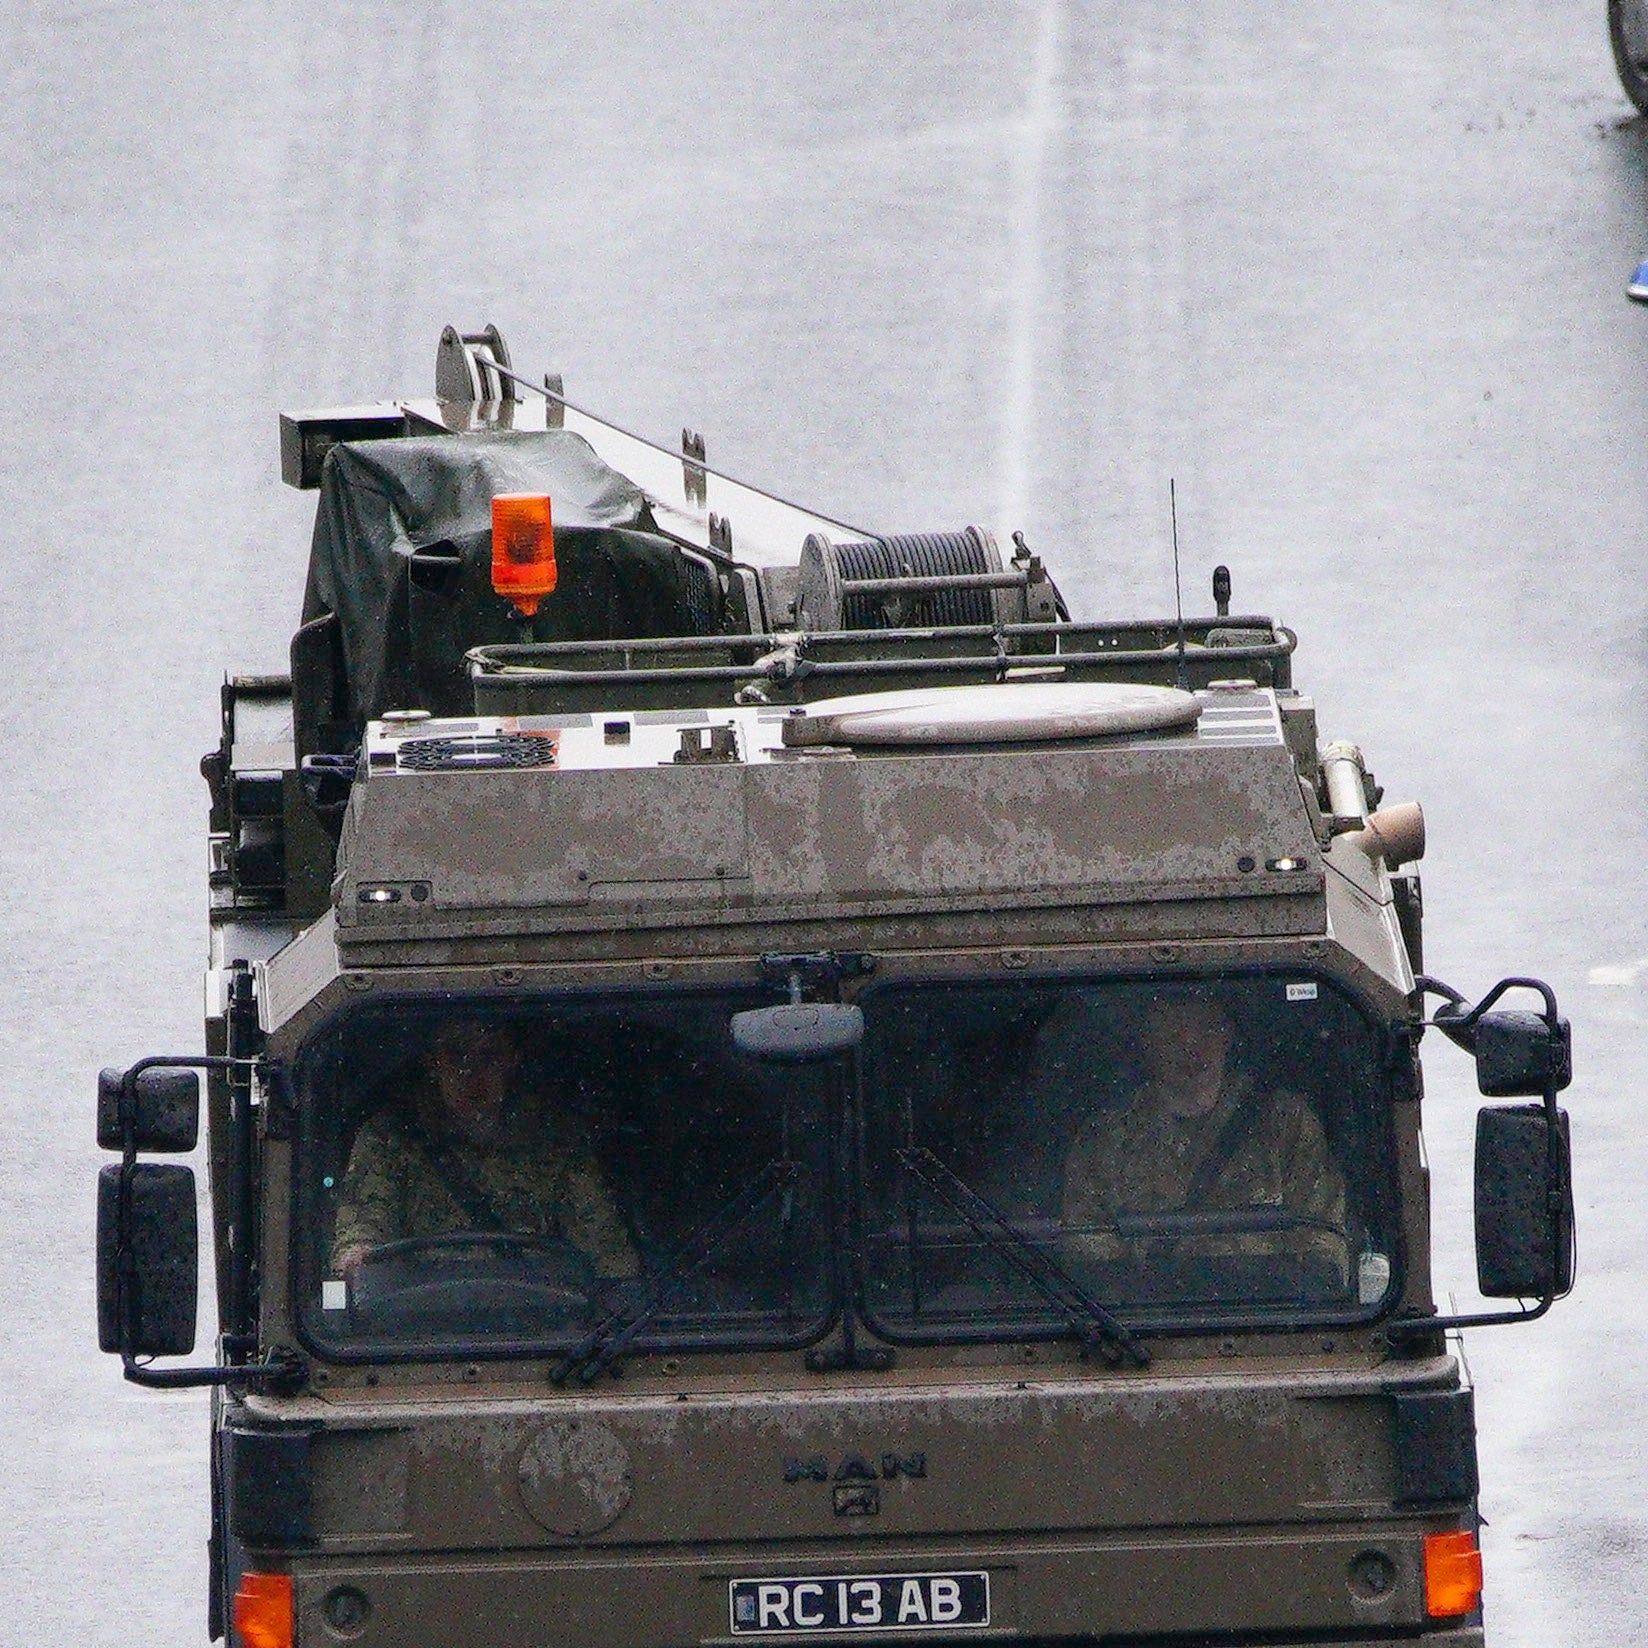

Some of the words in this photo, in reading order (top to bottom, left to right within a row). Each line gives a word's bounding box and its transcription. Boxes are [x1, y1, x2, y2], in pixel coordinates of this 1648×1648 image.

[757, 1583, 825, 1628] RC
[837, 1581, 882, 1625] 13
[897, 1579, 963, 1624] AB
